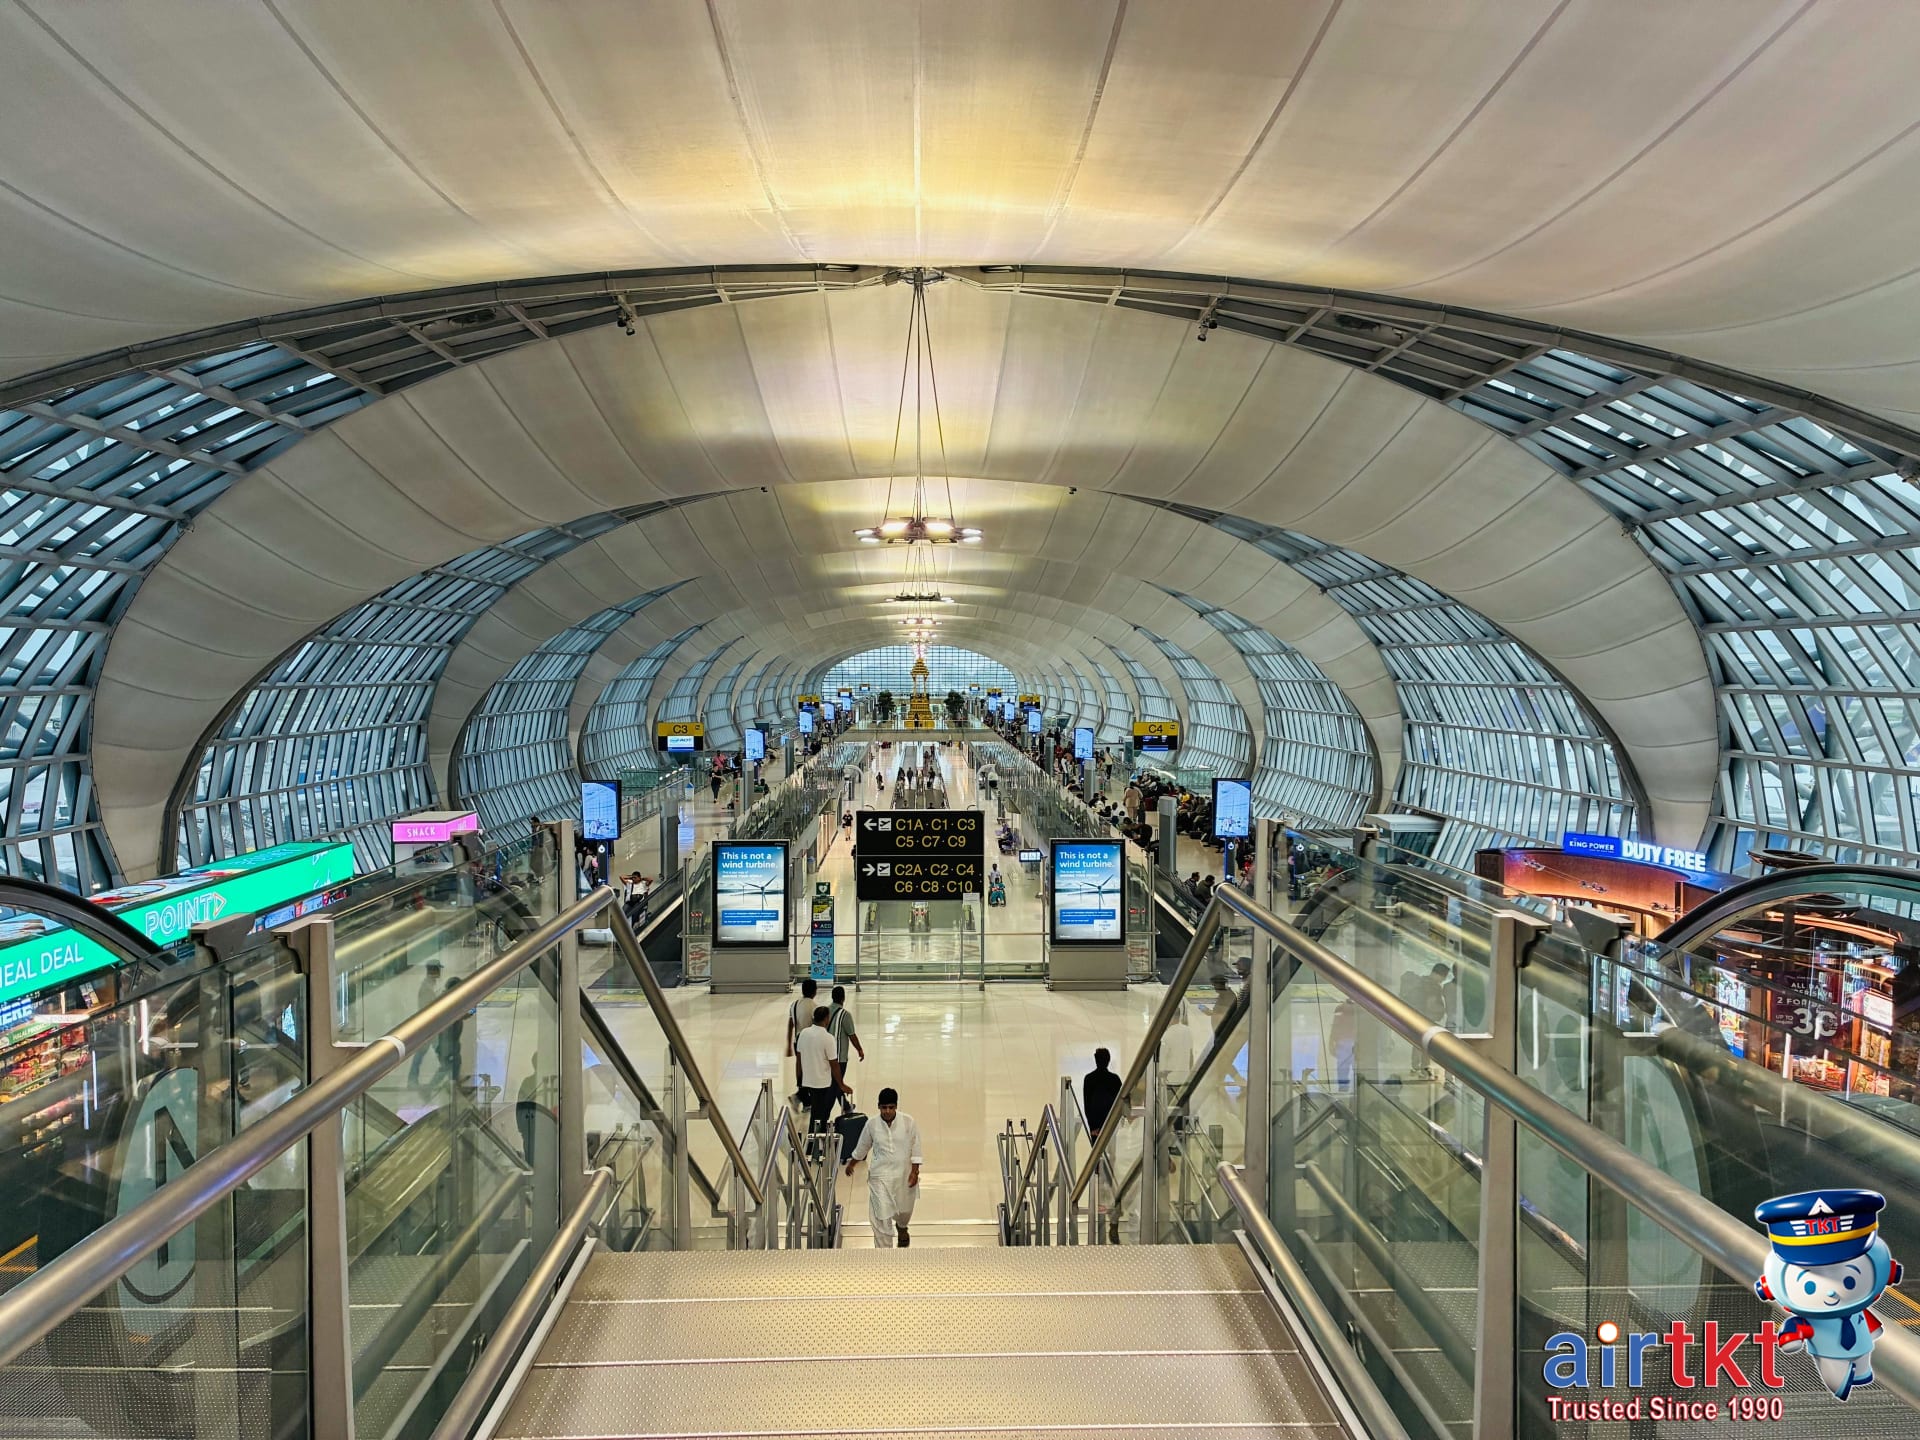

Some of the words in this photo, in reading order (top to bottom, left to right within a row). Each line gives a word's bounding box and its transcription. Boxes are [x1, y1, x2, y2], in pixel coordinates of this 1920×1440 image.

[673, 724, 688, 734] C3
[1148, 724, 1163, 734] C4
[895, 818, 924, 831] C1A
[931, 818, 948, 831] C1
[957, 818, 976, 831] C3
[407, 826, 436, 838] SNACK
[895, 835, 914, 848] C5
[921, 835, 940, 848] C7
[947, 835, 966, 848] C9
[1569, 840, 1588, 849] KING
[1588, 842, 1615, 851] POWER
[721, 852, 739, 860] This
[741, 852, 748, 860] is
[1059, 851, 1076, 859] This
[1078, 851, 1085, 859] is
[1622, 840, 1662, 863] DUTY
[1663, 847, 1706, 872] FREE
[721, 860, 743, 869] wind
[745, 860, 778, 869] turbine.
[894, 863, 923, 876] C2A
[930, 863, 949, 876] C2
[956, 863, 975, 876] C4
[1059, 860, 1080, 868] wind
[894, 880, 913, 893] C6
[920, 880, 939, 893] C8
[946, 880, 973, 893] C10
[145, 892, 214, 940] POINT
[41, 942, 84, 974] DEAL
